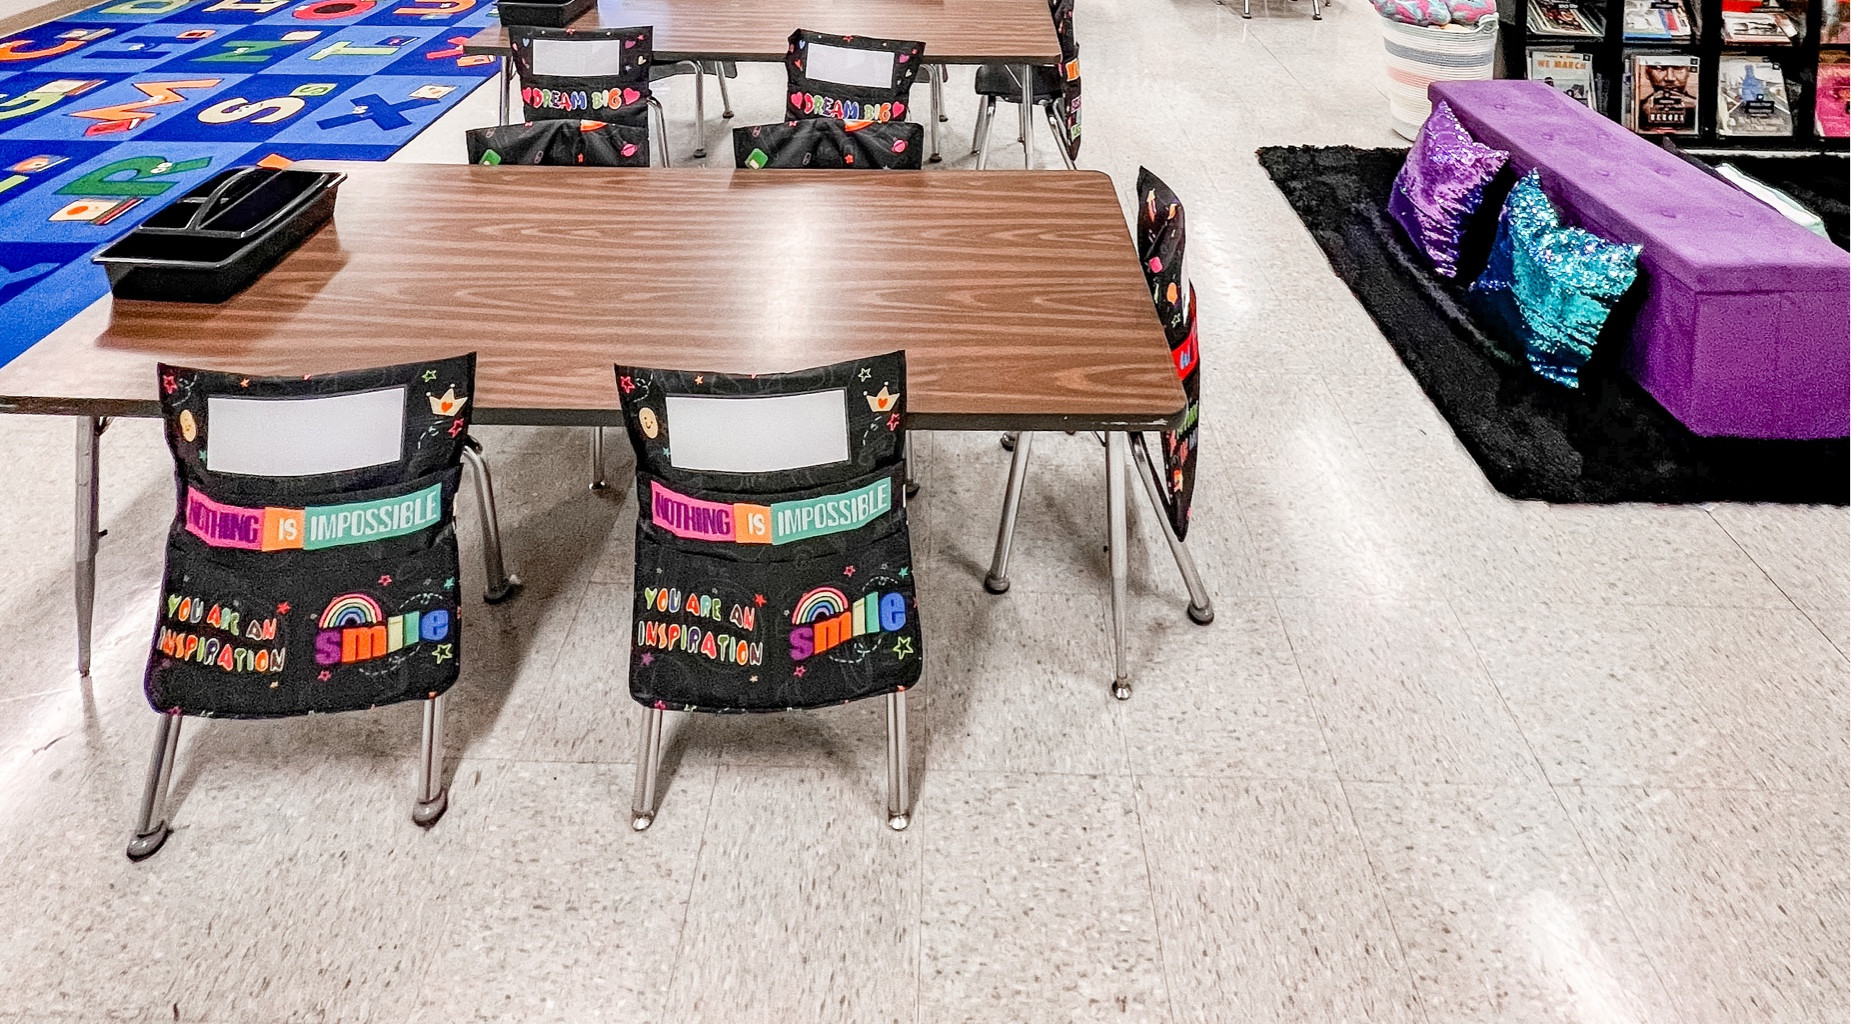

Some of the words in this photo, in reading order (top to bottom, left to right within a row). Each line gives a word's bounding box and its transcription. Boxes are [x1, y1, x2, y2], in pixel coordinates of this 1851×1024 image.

[1554, 60, 1587, 70] MARCH
[197, 96, 305, 124] S
[533, 87, 587, 112] DREAM
[591, 87, 622, 110] BIG
[803, 93, 860, 121] DREAM
[863, 102, 892, 123] BIG
[54, 156, 213, 196] R
[188, 494, 259, 544] NOTHING
[278, 517, 298, 541] IS
[310, 490, 438, 542] IMPOSSIBLE
[655, 490, 731, 537] NOTHING
[747, 513, 766, 537] IS
[777, 482, 888, 537] IMPOSSIBLE
[167, 593, 205, 624] YOU
[206, 603, 240, 636] ARE
[245, 617, 278, 641] AN
[644, 587, 682, 614] YOU
[685, 592, 722, 622] ARE
[729, 603, 756, 632] AN
[789, 591, 907, 662] smile
[157, 625, 287, 673] INSPIRATION
[315, 609, 451, 666] smile
[637, 620, 764, 667] INSPIRATION
